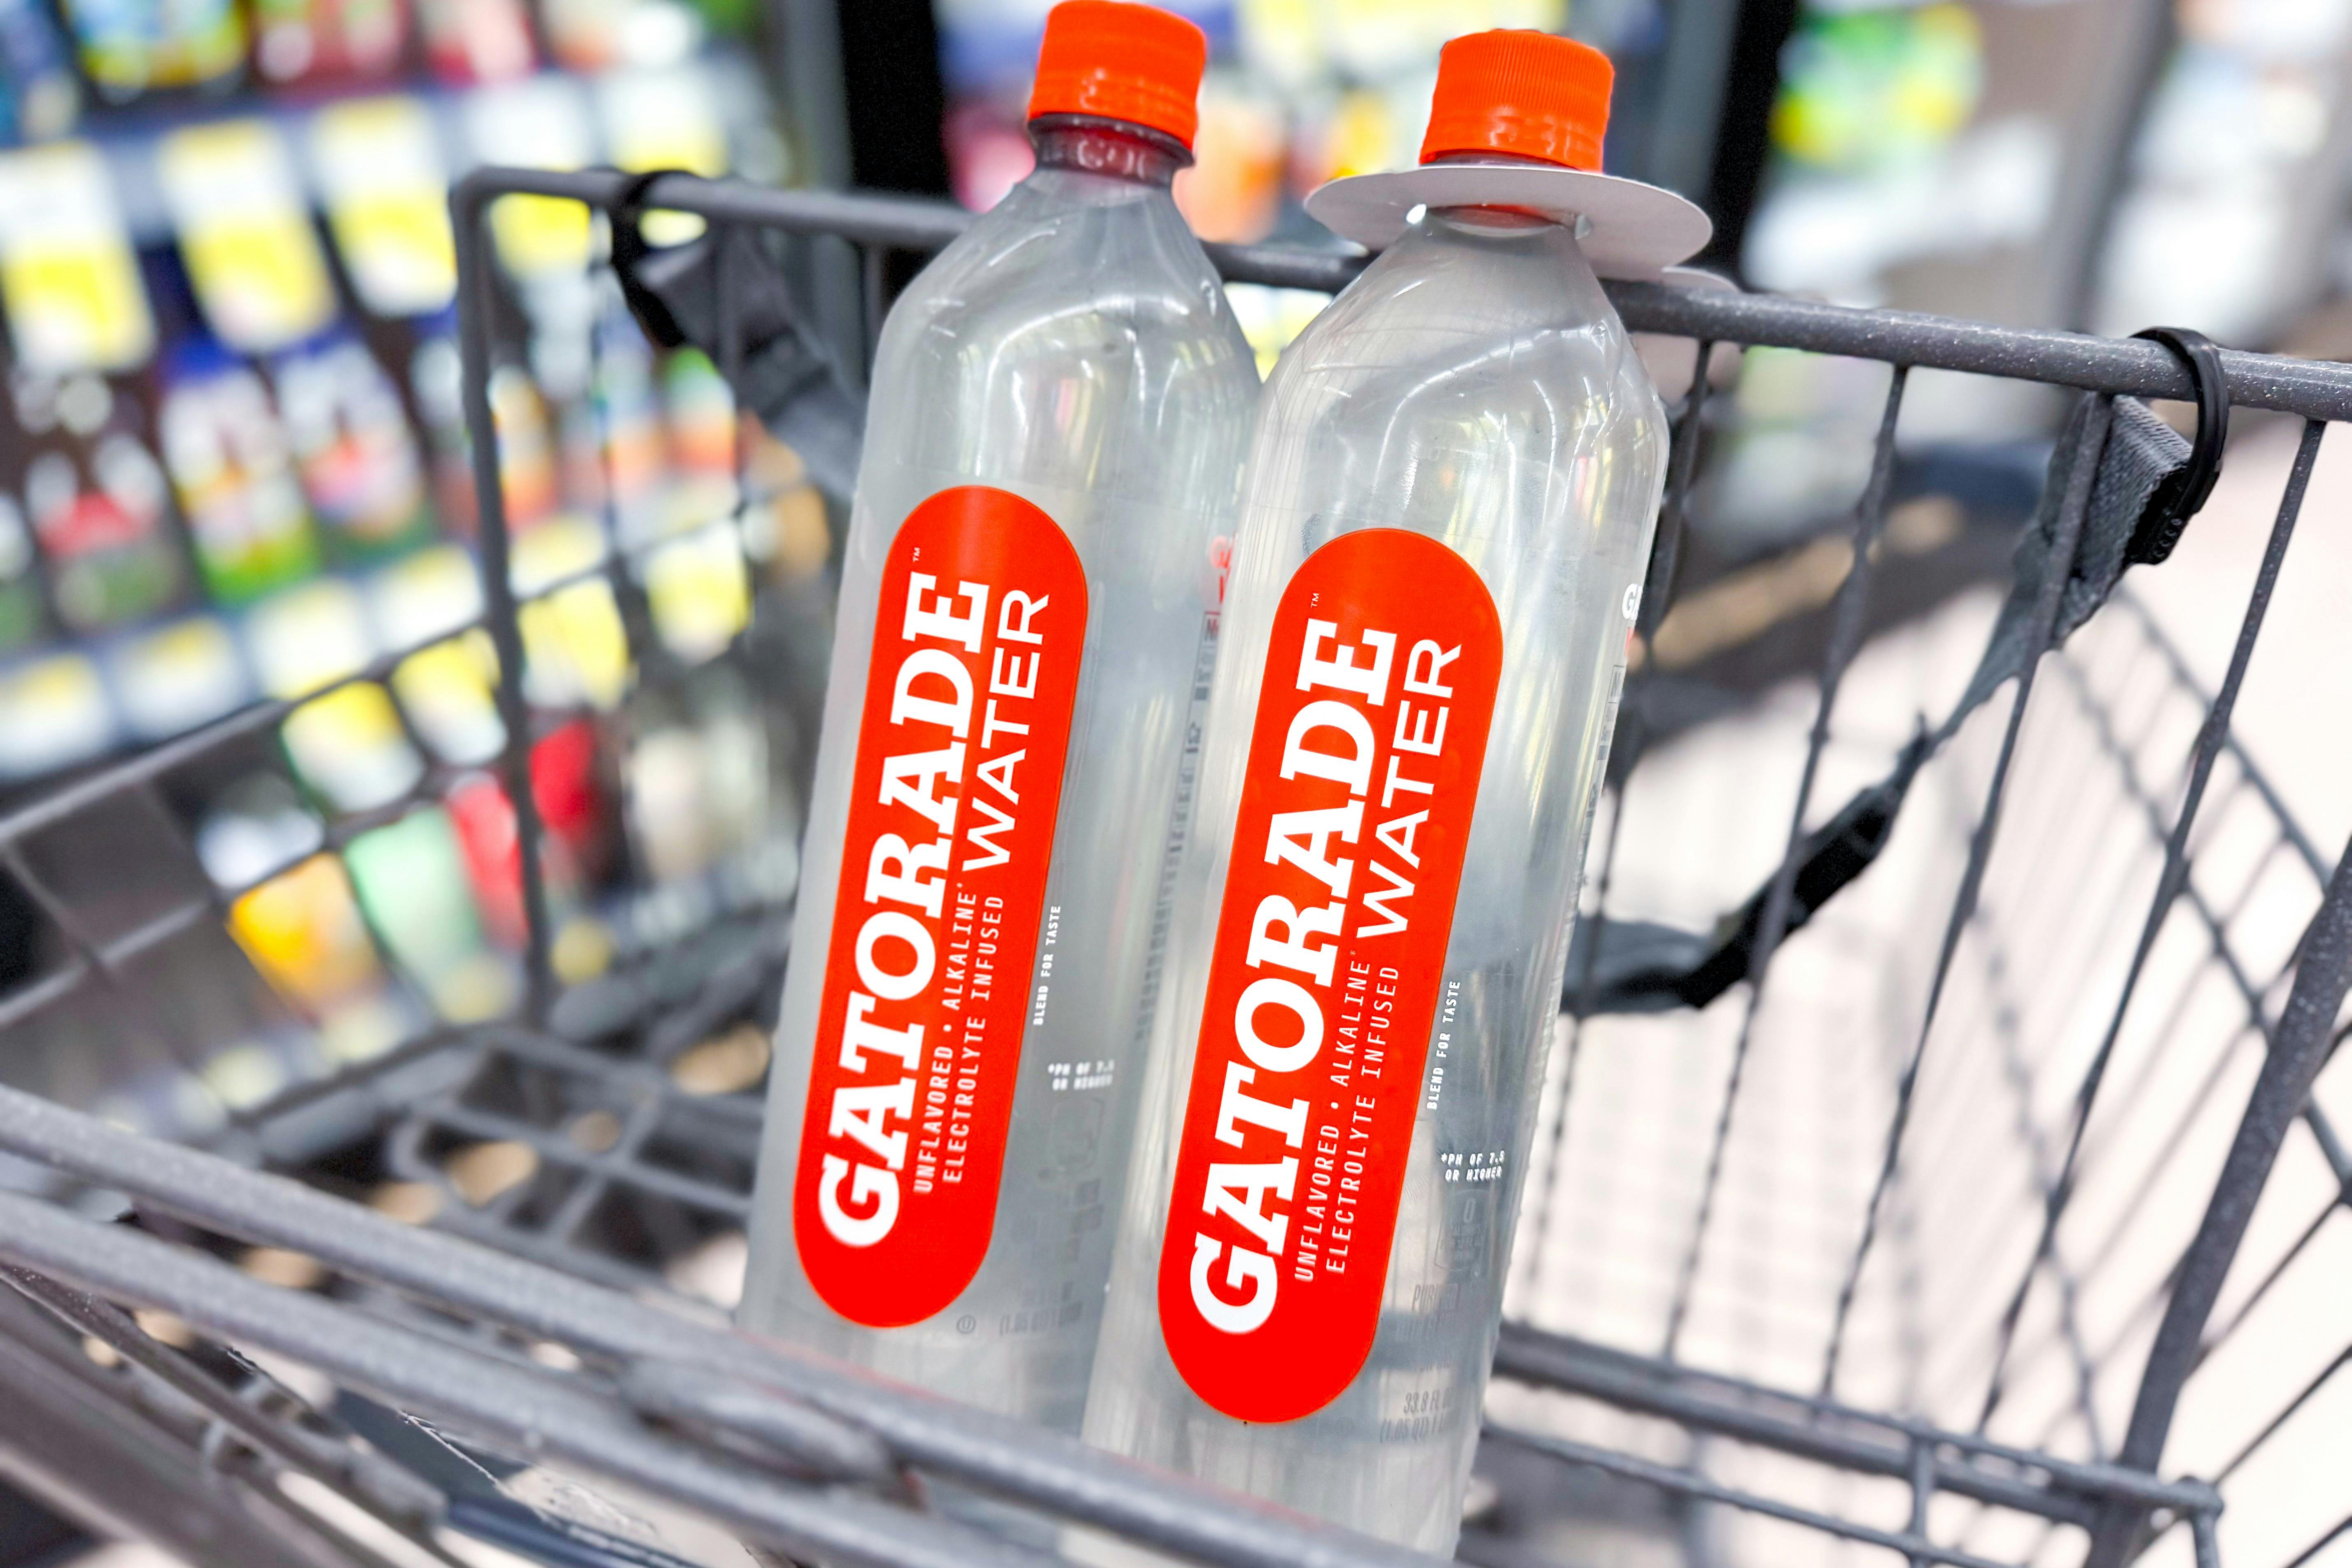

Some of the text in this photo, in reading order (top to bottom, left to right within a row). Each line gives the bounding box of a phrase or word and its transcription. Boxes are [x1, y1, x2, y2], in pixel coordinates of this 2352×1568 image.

[962, 590, 1049, 871] WATER
[1357, 639, 1462, 938] WATER
[819, 571, 989, 1246] GATORADE
[1033, 906, 1061, 1025] BLEND FOR TASTE
[1190, 618, 1397, 1334] GATORADE
[943, 897, 1003, 1183] ELECTROLYTE INFUSED
[1426, 980, 1461, 1111] BLEND FOR TASTE
[914, 1046, 953, 1193] UNFLAVORED
[1325, 967, 1399, 1273] ELECTROLYTE INFUSED
[1445, 1166, 1503, 1182] OR HIGHER
[1469, 1153, 1483, 1166] OF
[1489, 1150, 1505, 1164] 7.5
[1294, 1125, 1339, 1281] UNFLAVORED
[1403, 1390, 1429, 1414] 33.8
